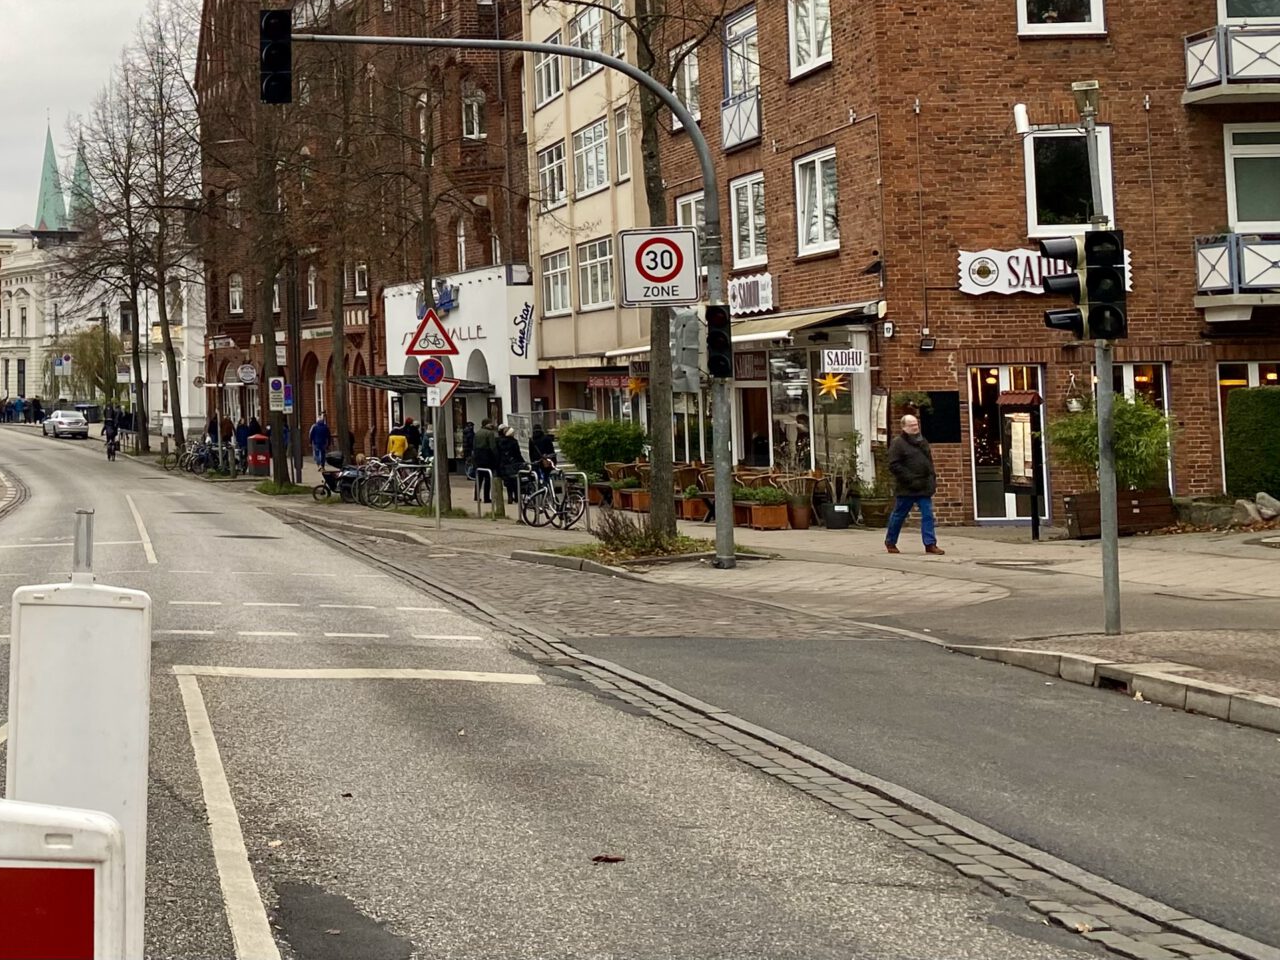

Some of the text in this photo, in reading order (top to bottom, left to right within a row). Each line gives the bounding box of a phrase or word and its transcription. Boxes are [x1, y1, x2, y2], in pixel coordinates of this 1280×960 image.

[645, 250, 673, 270] 30
[1007, 255, 1069, 288] SADH
[643, 286, 679, 297] ZONE
[738, 280, 760, 308] SADHU
[511, 301, 532, 357] CineStar
[826, 351, 862, 366] SADHU
